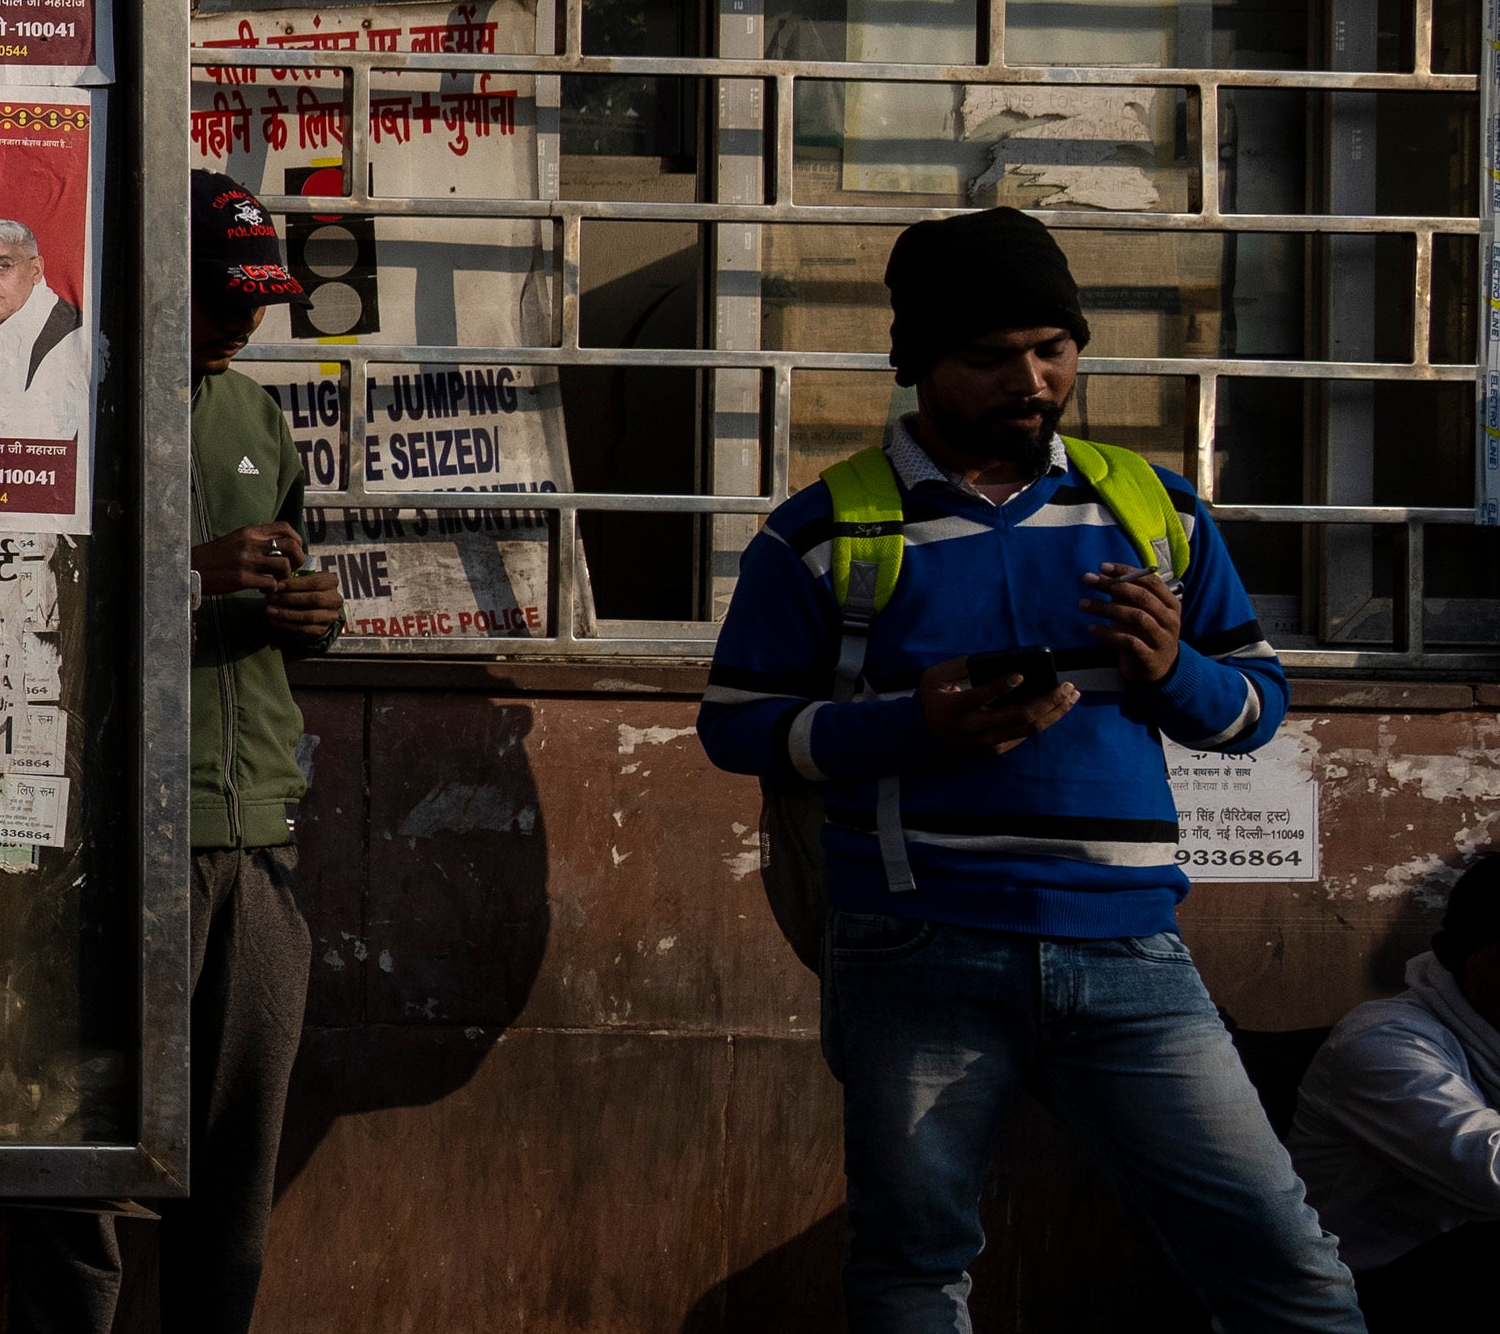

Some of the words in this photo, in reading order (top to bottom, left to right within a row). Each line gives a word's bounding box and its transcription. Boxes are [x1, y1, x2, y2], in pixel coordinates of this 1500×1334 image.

[261, 88, 288, 151] के
[387, 367, 518, 423] JUMPING
[321, 550, 392, 600] FINE
[355, 613, 453, 637] TRAFFIC
[459, 607, 541, 634] POLICE
[1197, 809, 1214, 821] सिंह
